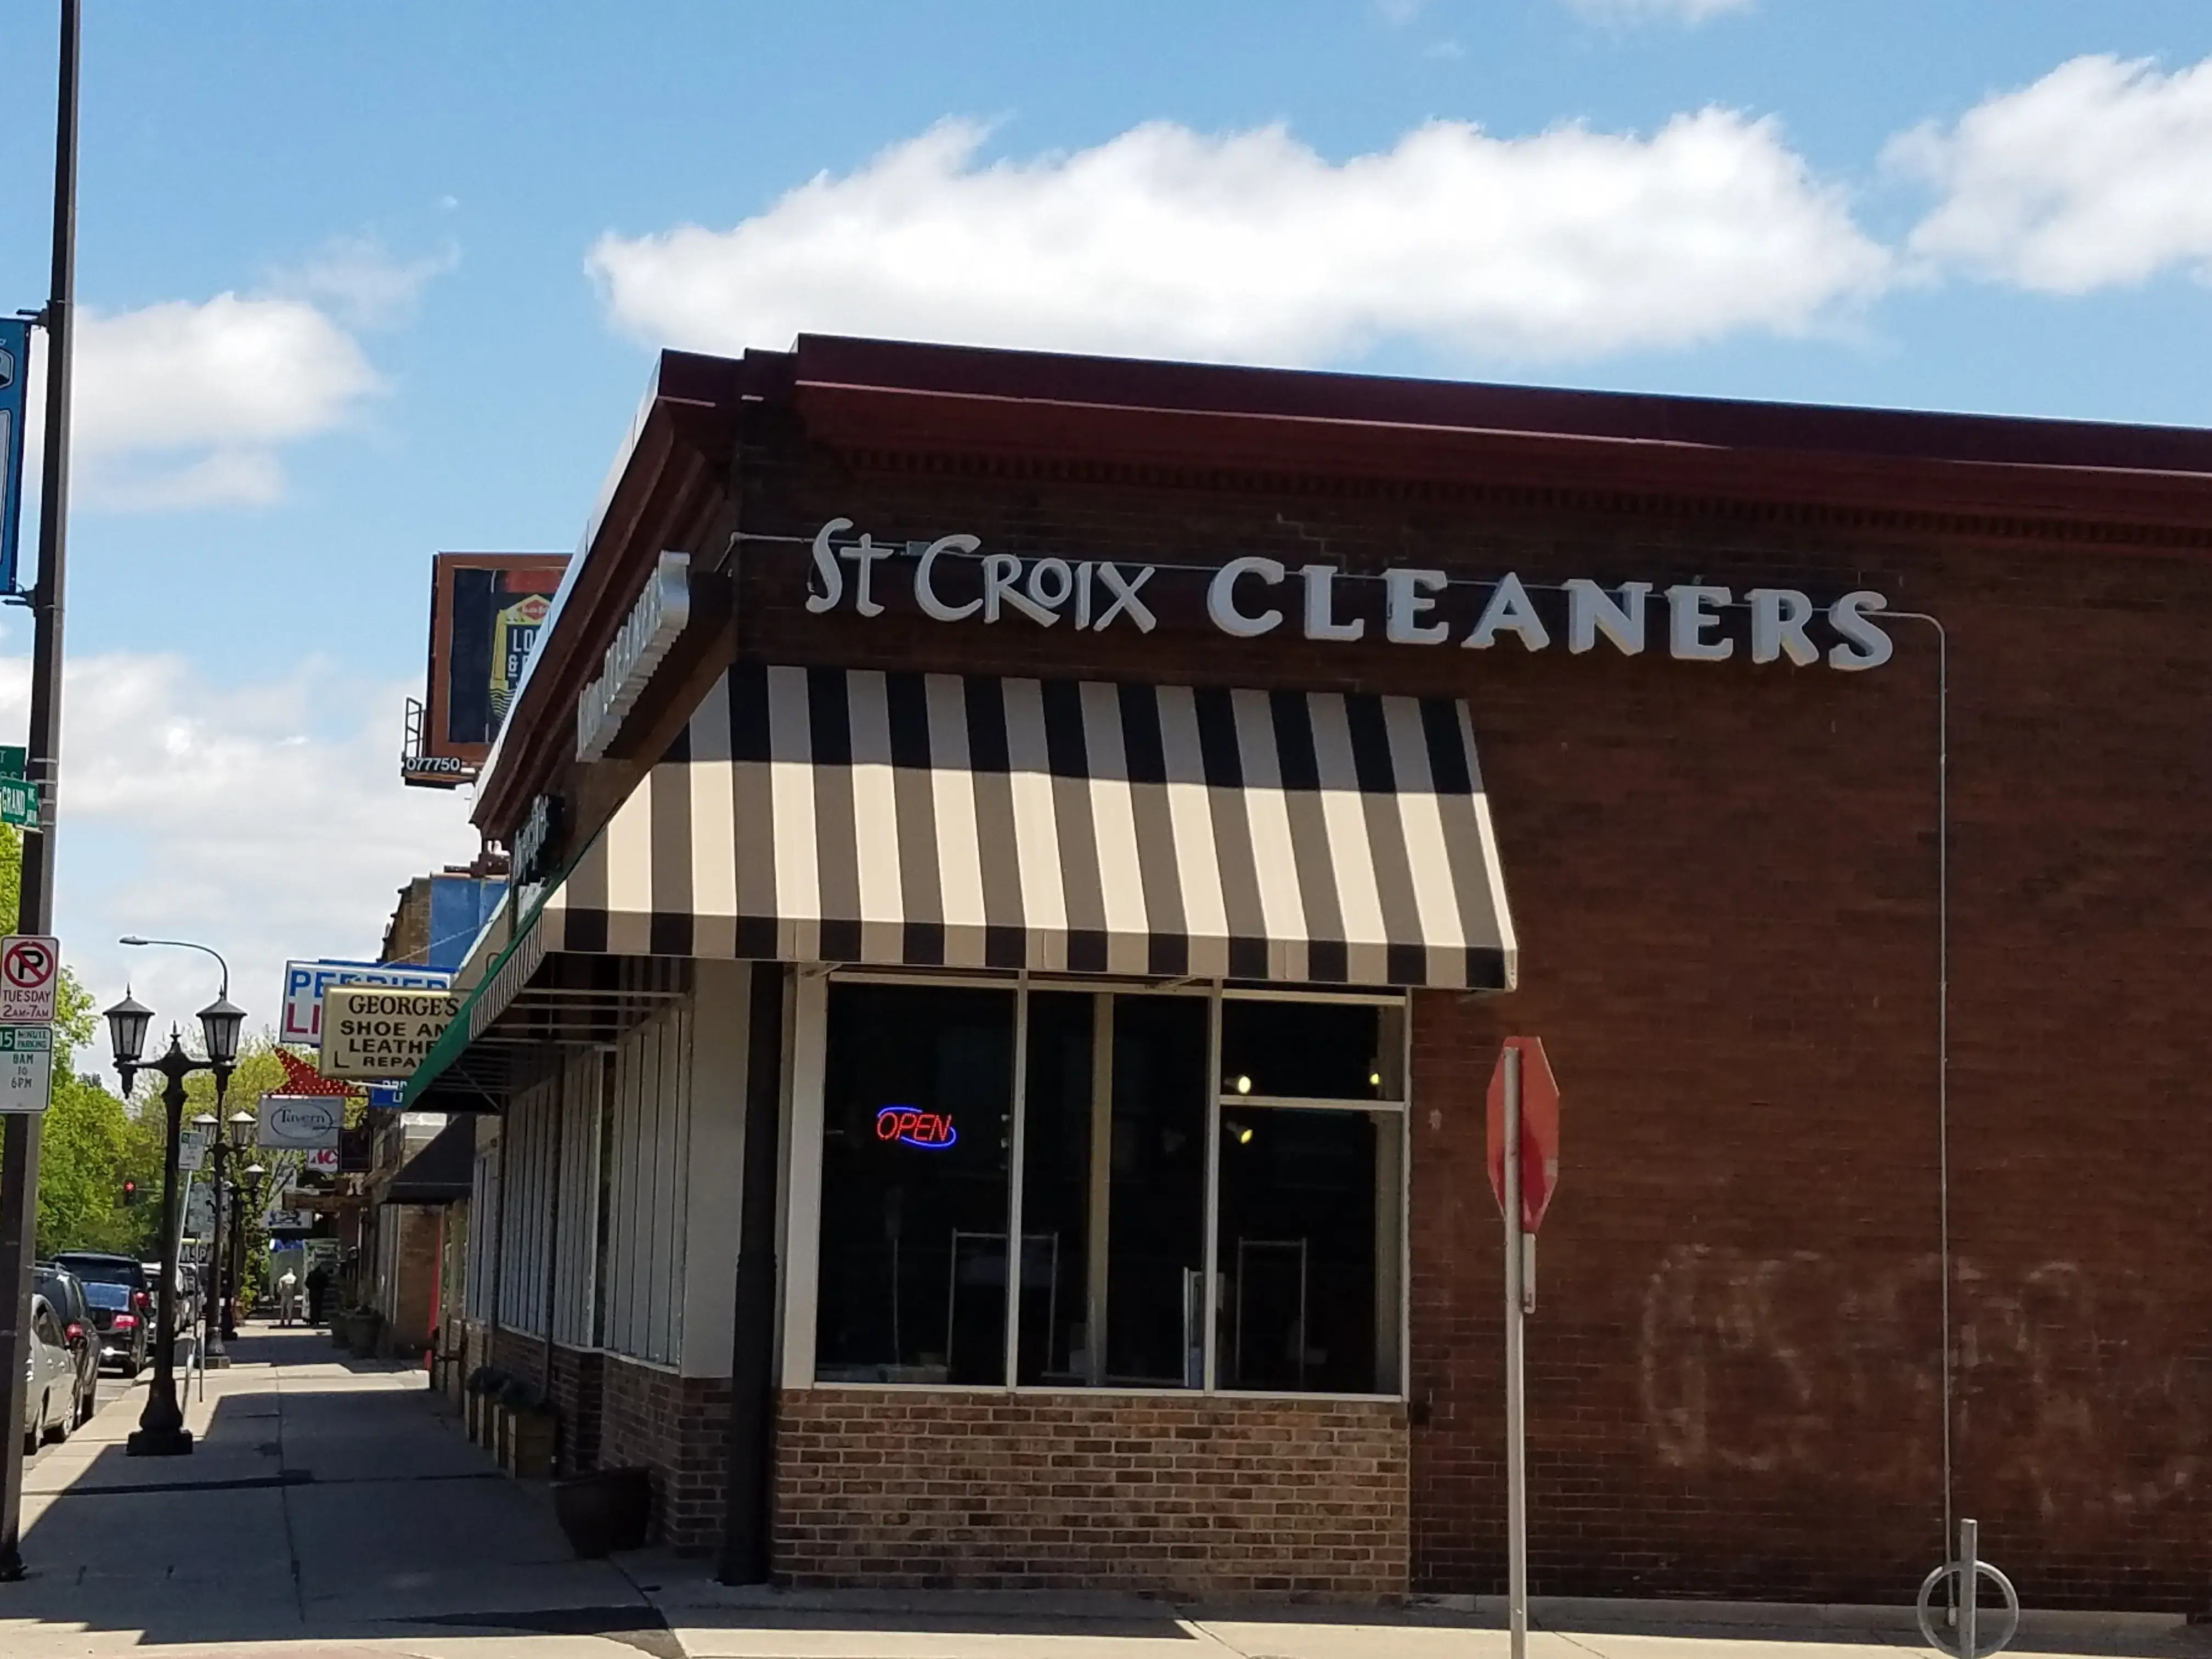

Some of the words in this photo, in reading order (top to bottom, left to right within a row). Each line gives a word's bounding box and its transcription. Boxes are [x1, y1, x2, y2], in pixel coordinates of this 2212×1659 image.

[805, 517, 894, 618] St
[1207, 556, 1894, 672] CLEANERS
[513, 629, 539, 652] LO
[406, 757, 460, 771] 077750
[2, 786, 26, 816] GRAND
[3, 989, 51, 1003] TUESDAY
[348, 995, 460, 1017] GEORGE'S
[18, 1030, 48, 1039] MINUTE
[340, 1020, 407, 1036] SHOE
[18, 1040, 48, 1048] PARKING
[13, 1053, 34, 1065] 8AM
[10, 1077, 32, 1089] 6PM
[281, 1109, 325, 1123] Tavern
[876, 1112, 952, 1142] OPEN
